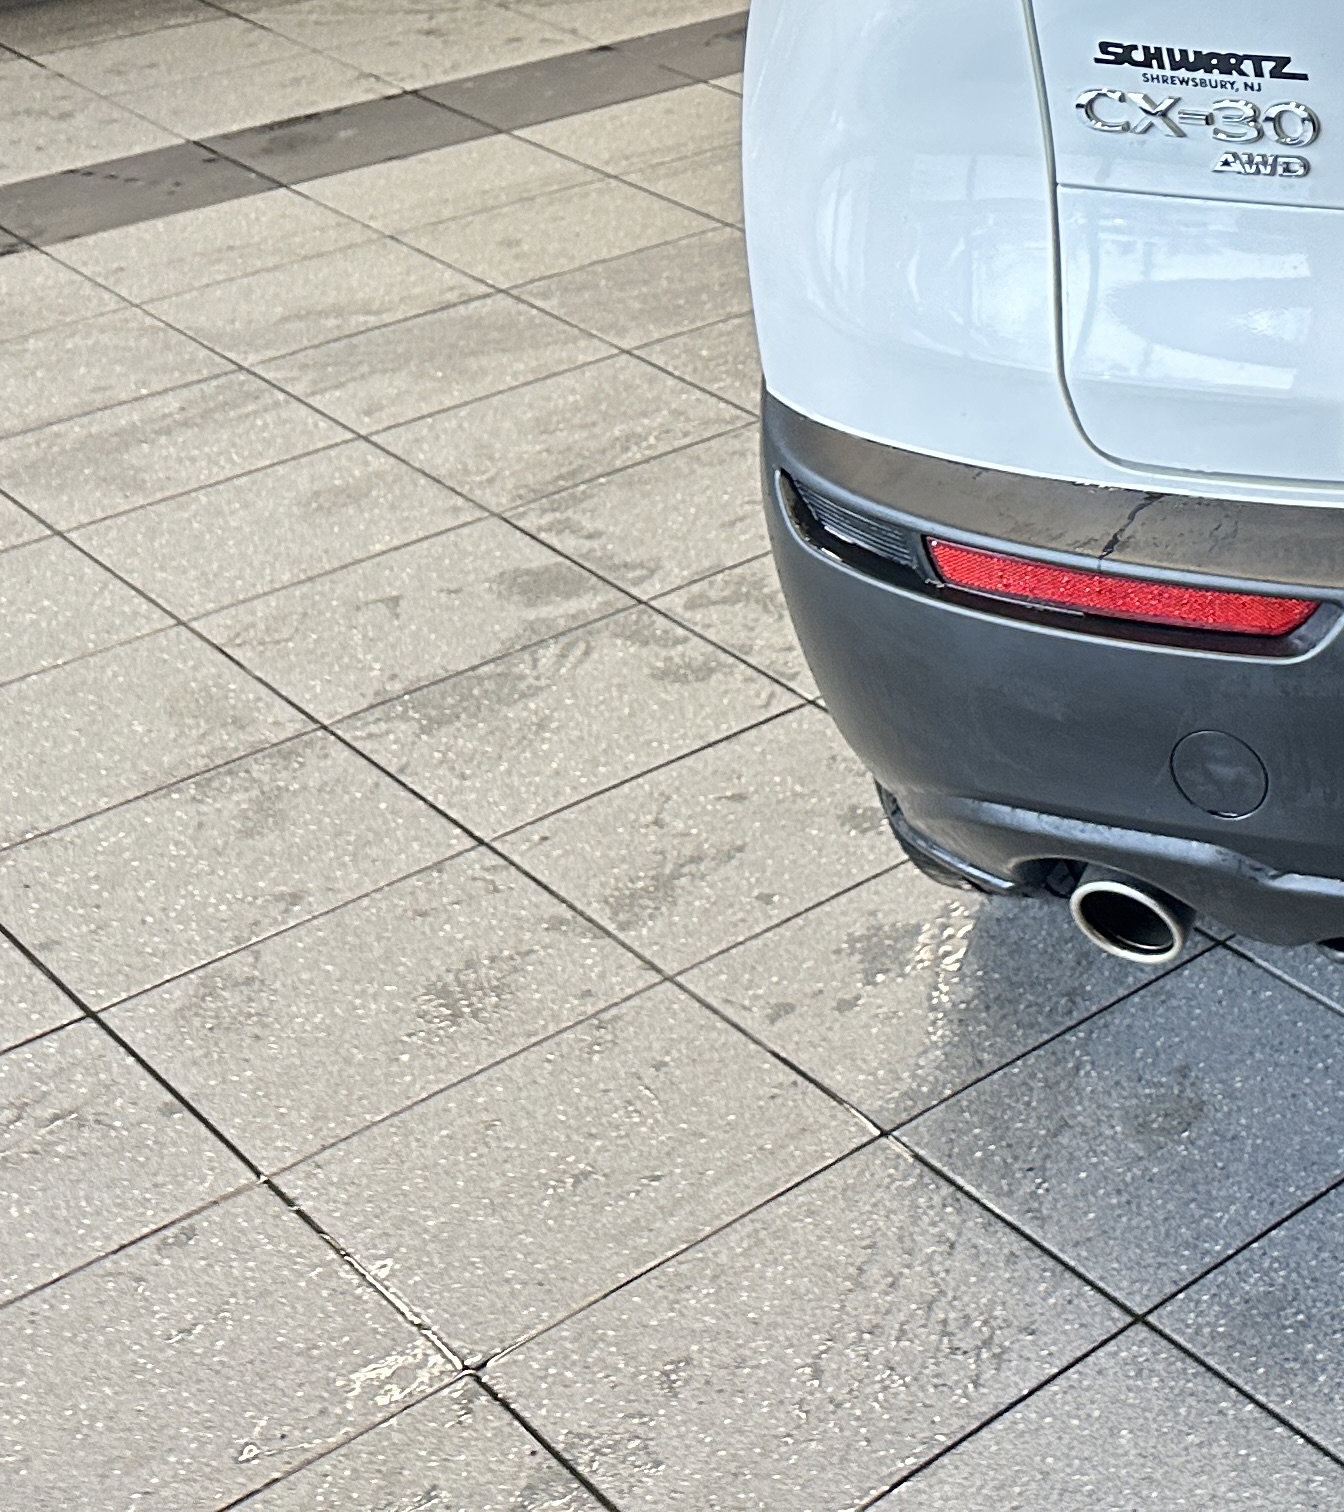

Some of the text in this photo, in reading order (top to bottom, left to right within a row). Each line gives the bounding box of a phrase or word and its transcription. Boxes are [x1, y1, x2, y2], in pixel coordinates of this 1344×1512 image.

[1093, 40, 1309, 82] SCHWARTZ
[1142, 72, 1262, 93] SHREWSBURY, NJ
[1074, 87, 1322, 148] CX-30
[1211, 150, 1312, 178] AWD
